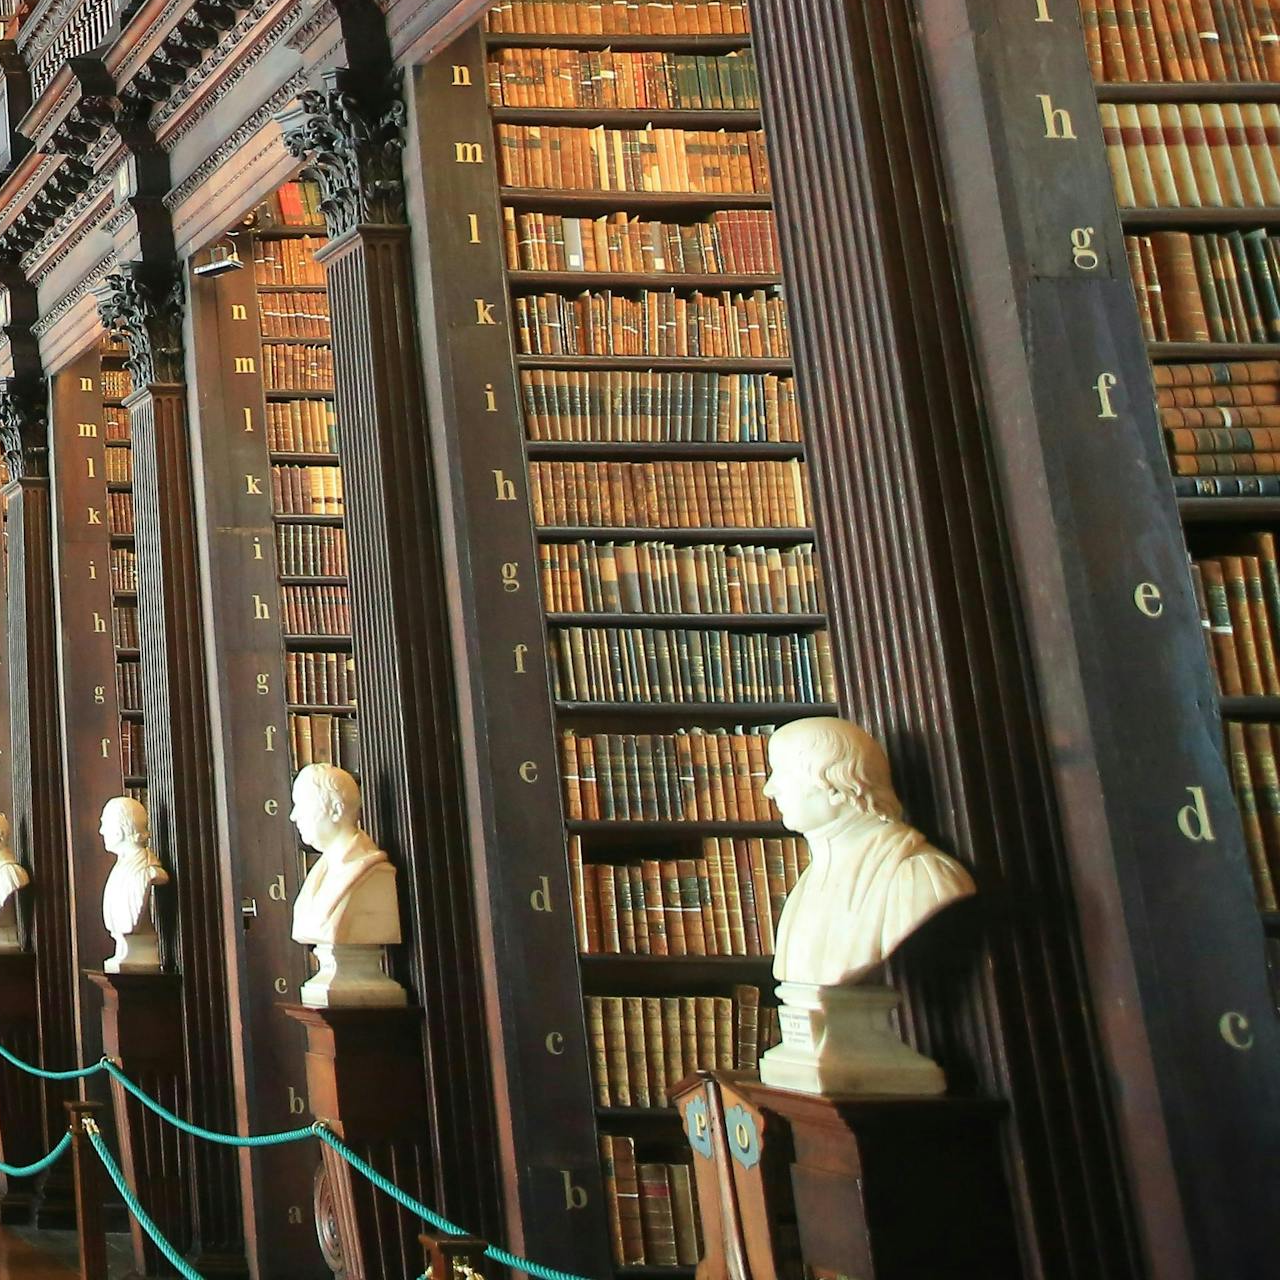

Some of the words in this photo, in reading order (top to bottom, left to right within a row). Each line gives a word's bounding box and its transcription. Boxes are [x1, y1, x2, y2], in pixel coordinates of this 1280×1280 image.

[452, 65, 472, 85] n
[1036, 95, 1077, 139] h
[455, 142, 483, 162] m
[468, 214, 480, 243] l
[1071, 227, 1098, 269] g
[232, 304, 247, 319] n
[475, 300, 496, 324] k
[235, 358, 255, 373] m
[80, 378, 92, 391] n
[1093, 373, 1117, 417] f
[485, 384, 497, 411] i
[78, 424, 96, 437] m
[244, 408, 253, 431] l
[87, 458, 95, 477] l
[246, 475, 262, 494] k
[492, 470, 516, 500] h
[88, 508, 101, 524] k
[254, 537, 262, 559] i
[89, 561, 96, 579] i
[502, 563, 519, 592] g
[253, 595, 269, 619] h
[1135, 583, 1162, 616] e
[94, 613, 106, 632] h
[514, 644, 527, 672] f
[95, 686, 104, 703] g
[256, 673, 269, 694] g
[102, 738, 110, 758] f
[266, 726, 276, 751] f
[520, 760, 538, 782] e
[264, 799, 278, 815] e
[1178, 787, 1214, 840] d
[269, 875, 286, 900] d
[531, 876, 552, 912] d
[275, 978, 288, 994] c
[1220, 1012, 1252, 1048] c
[546, 1032, 563, 1054] c
[289, 1087, 304, 1113] b
[695, 1113, 706, 1138] P
[560, 1171, 587, 1210] b
[288, 1206, 302, 1224] a
